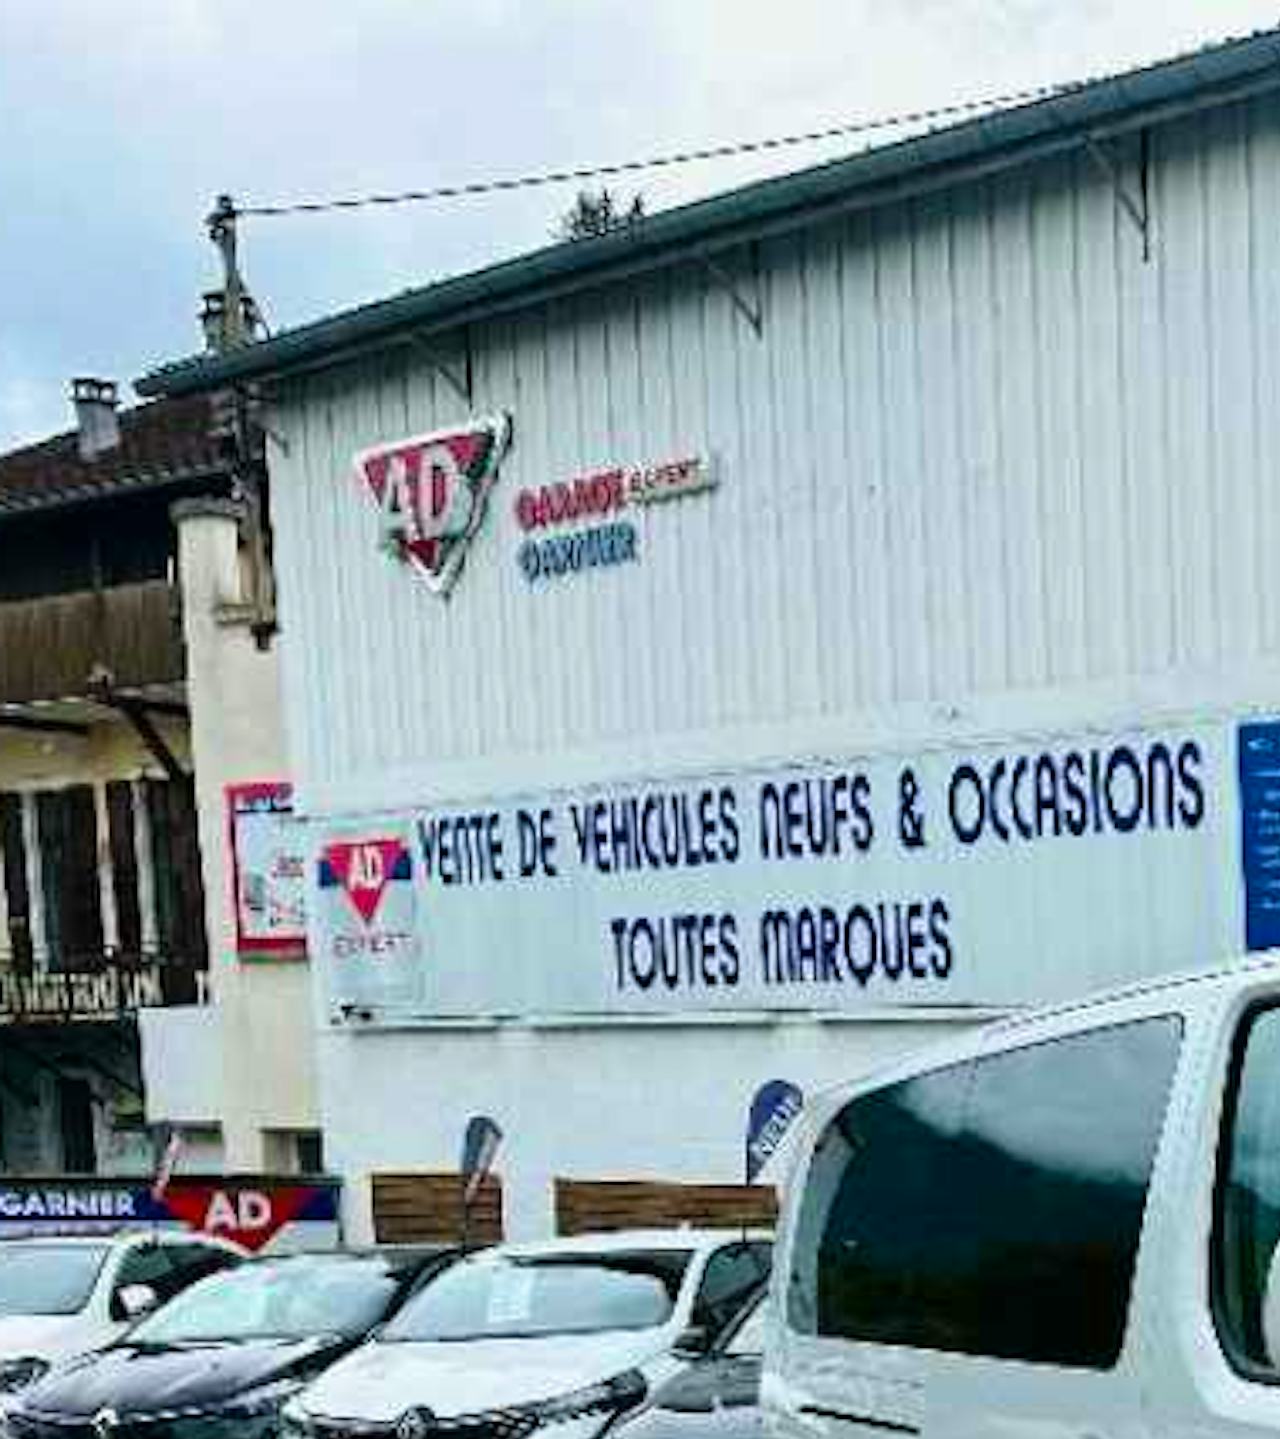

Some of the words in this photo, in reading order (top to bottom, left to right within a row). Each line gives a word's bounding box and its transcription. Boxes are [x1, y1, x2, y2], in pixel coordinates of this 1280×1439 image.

[417, 810, 504, 885] VENTE
[518, 808, 558, 879] DE
[575, 788, 739, 875] VEHICULES
[761, 773, 874, 861] NEUFS
[900, 768, 926, 848] &
[948, 739, 1203, 846] OCCASIONS
[350, 845, 384, 889] AD
[611, 914, 739, 990] TOUTES
[761, 899, 953, 983] MARQUES
[0, 1189, 137, 1217] GARNIER
[204, 1191, 273, 1229] AD
